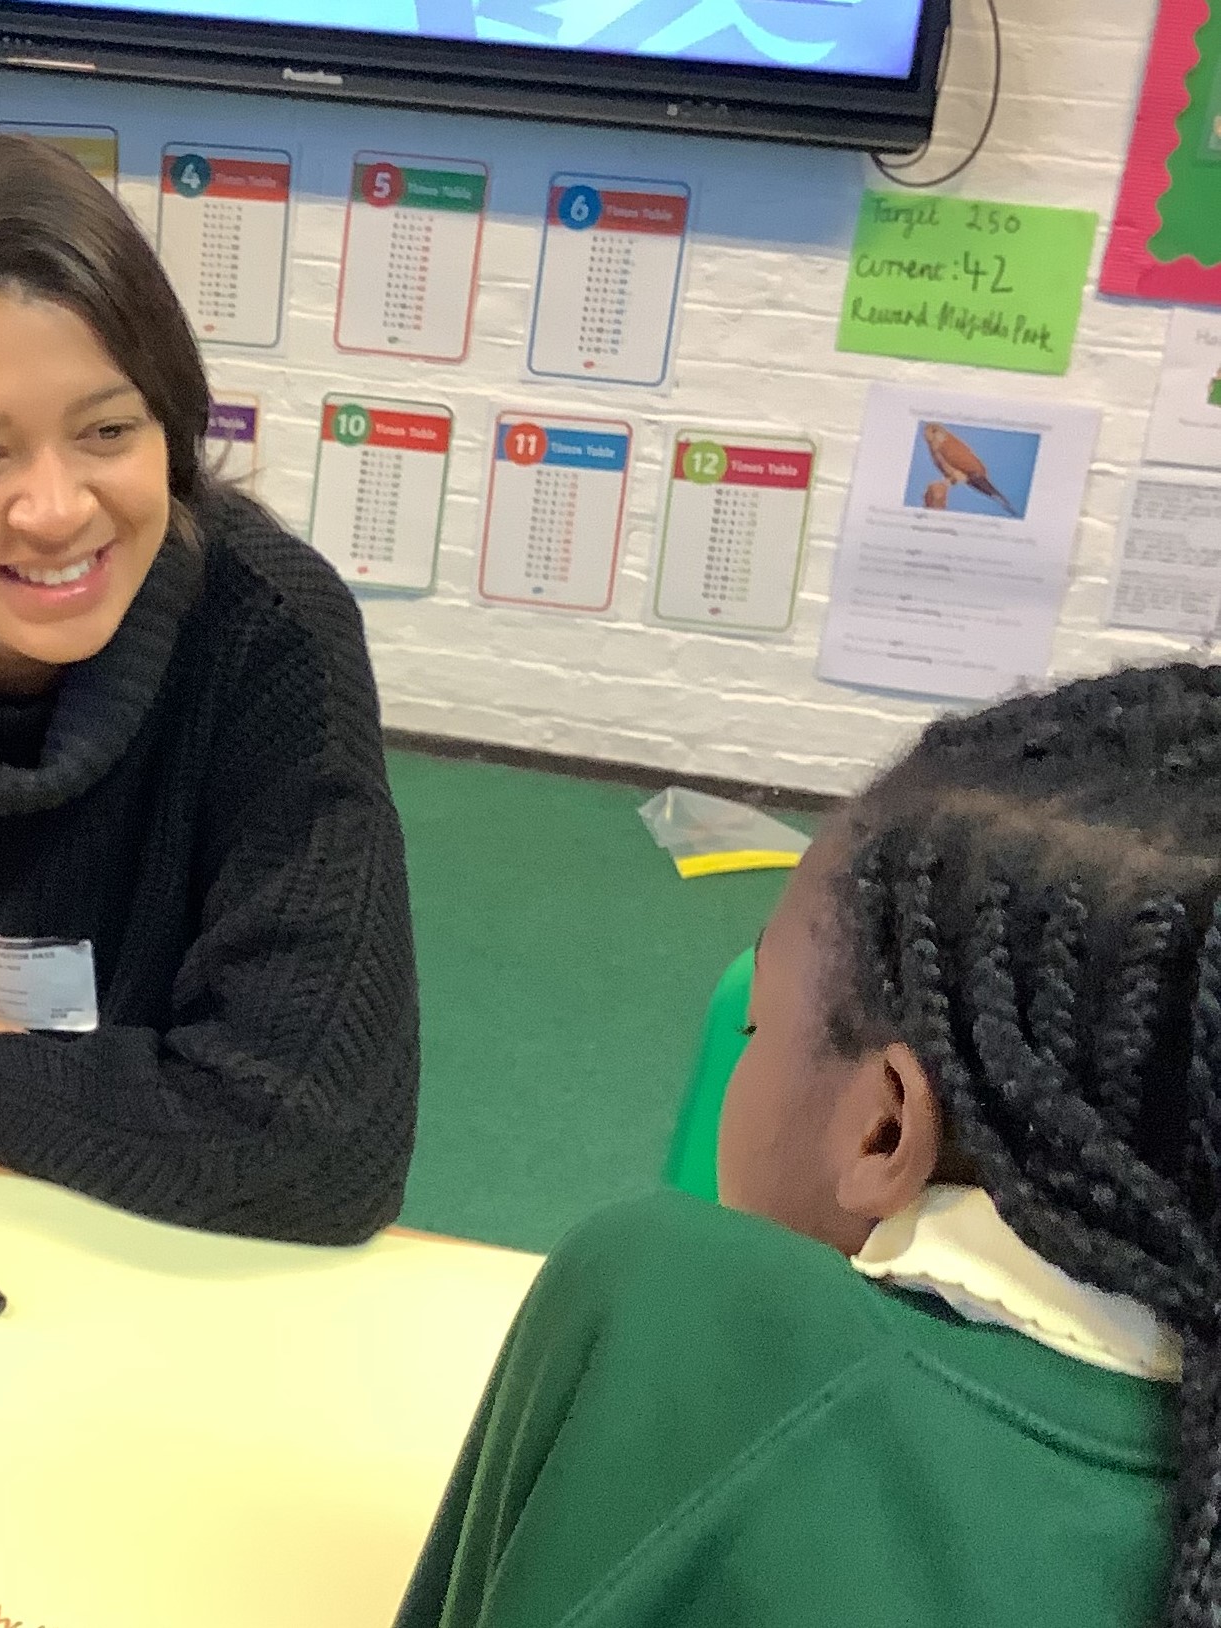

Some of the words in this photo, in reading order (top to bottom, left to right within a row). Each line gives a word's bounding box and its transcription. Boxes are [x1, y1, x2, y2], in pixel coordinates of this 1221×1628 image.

[180, 163, 201, 190] 4
[374, 171, 391, 199] 5
[570, 194, 589, 222] 6
[873, 197, 940, 239] Target
[966, 204, 1021, 235] 250
[851, 296, 928, 327] Reward
[336, 413, 367, 438] 10
[515, 433, 537, 456] 11
[692, 452, 719, 476] 12
